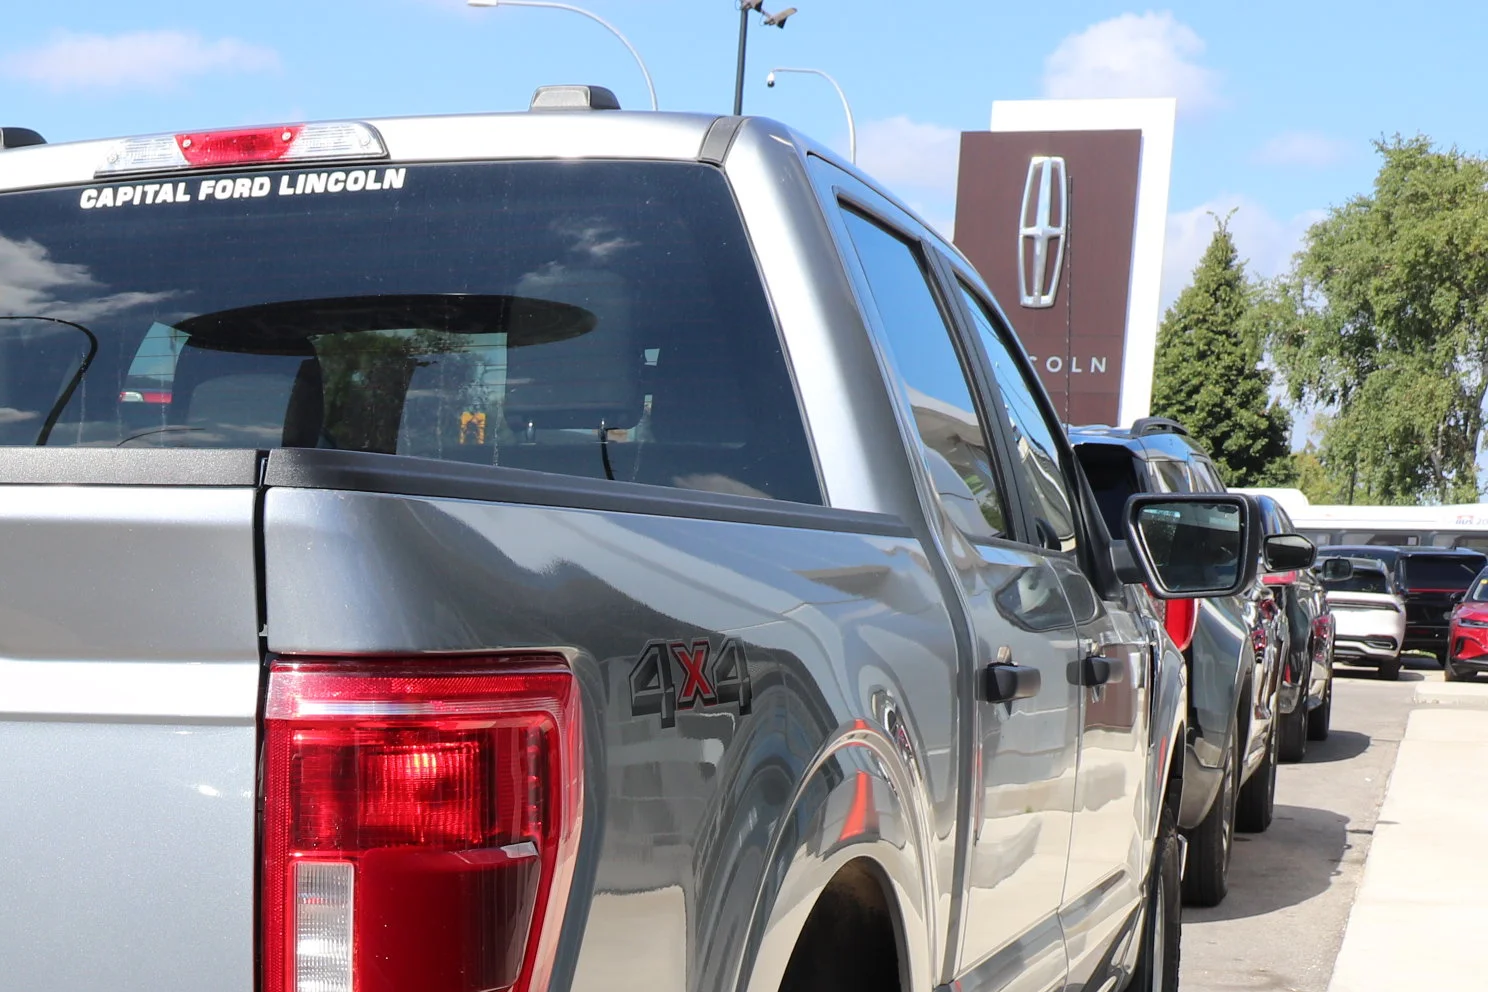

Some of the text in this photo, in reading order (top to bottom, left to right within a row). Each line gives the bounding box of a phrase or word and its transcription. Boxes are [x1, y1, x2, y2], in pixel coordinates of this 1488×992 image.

[79, 168, 407, 209] CAPITAL FORD LINCOLN
